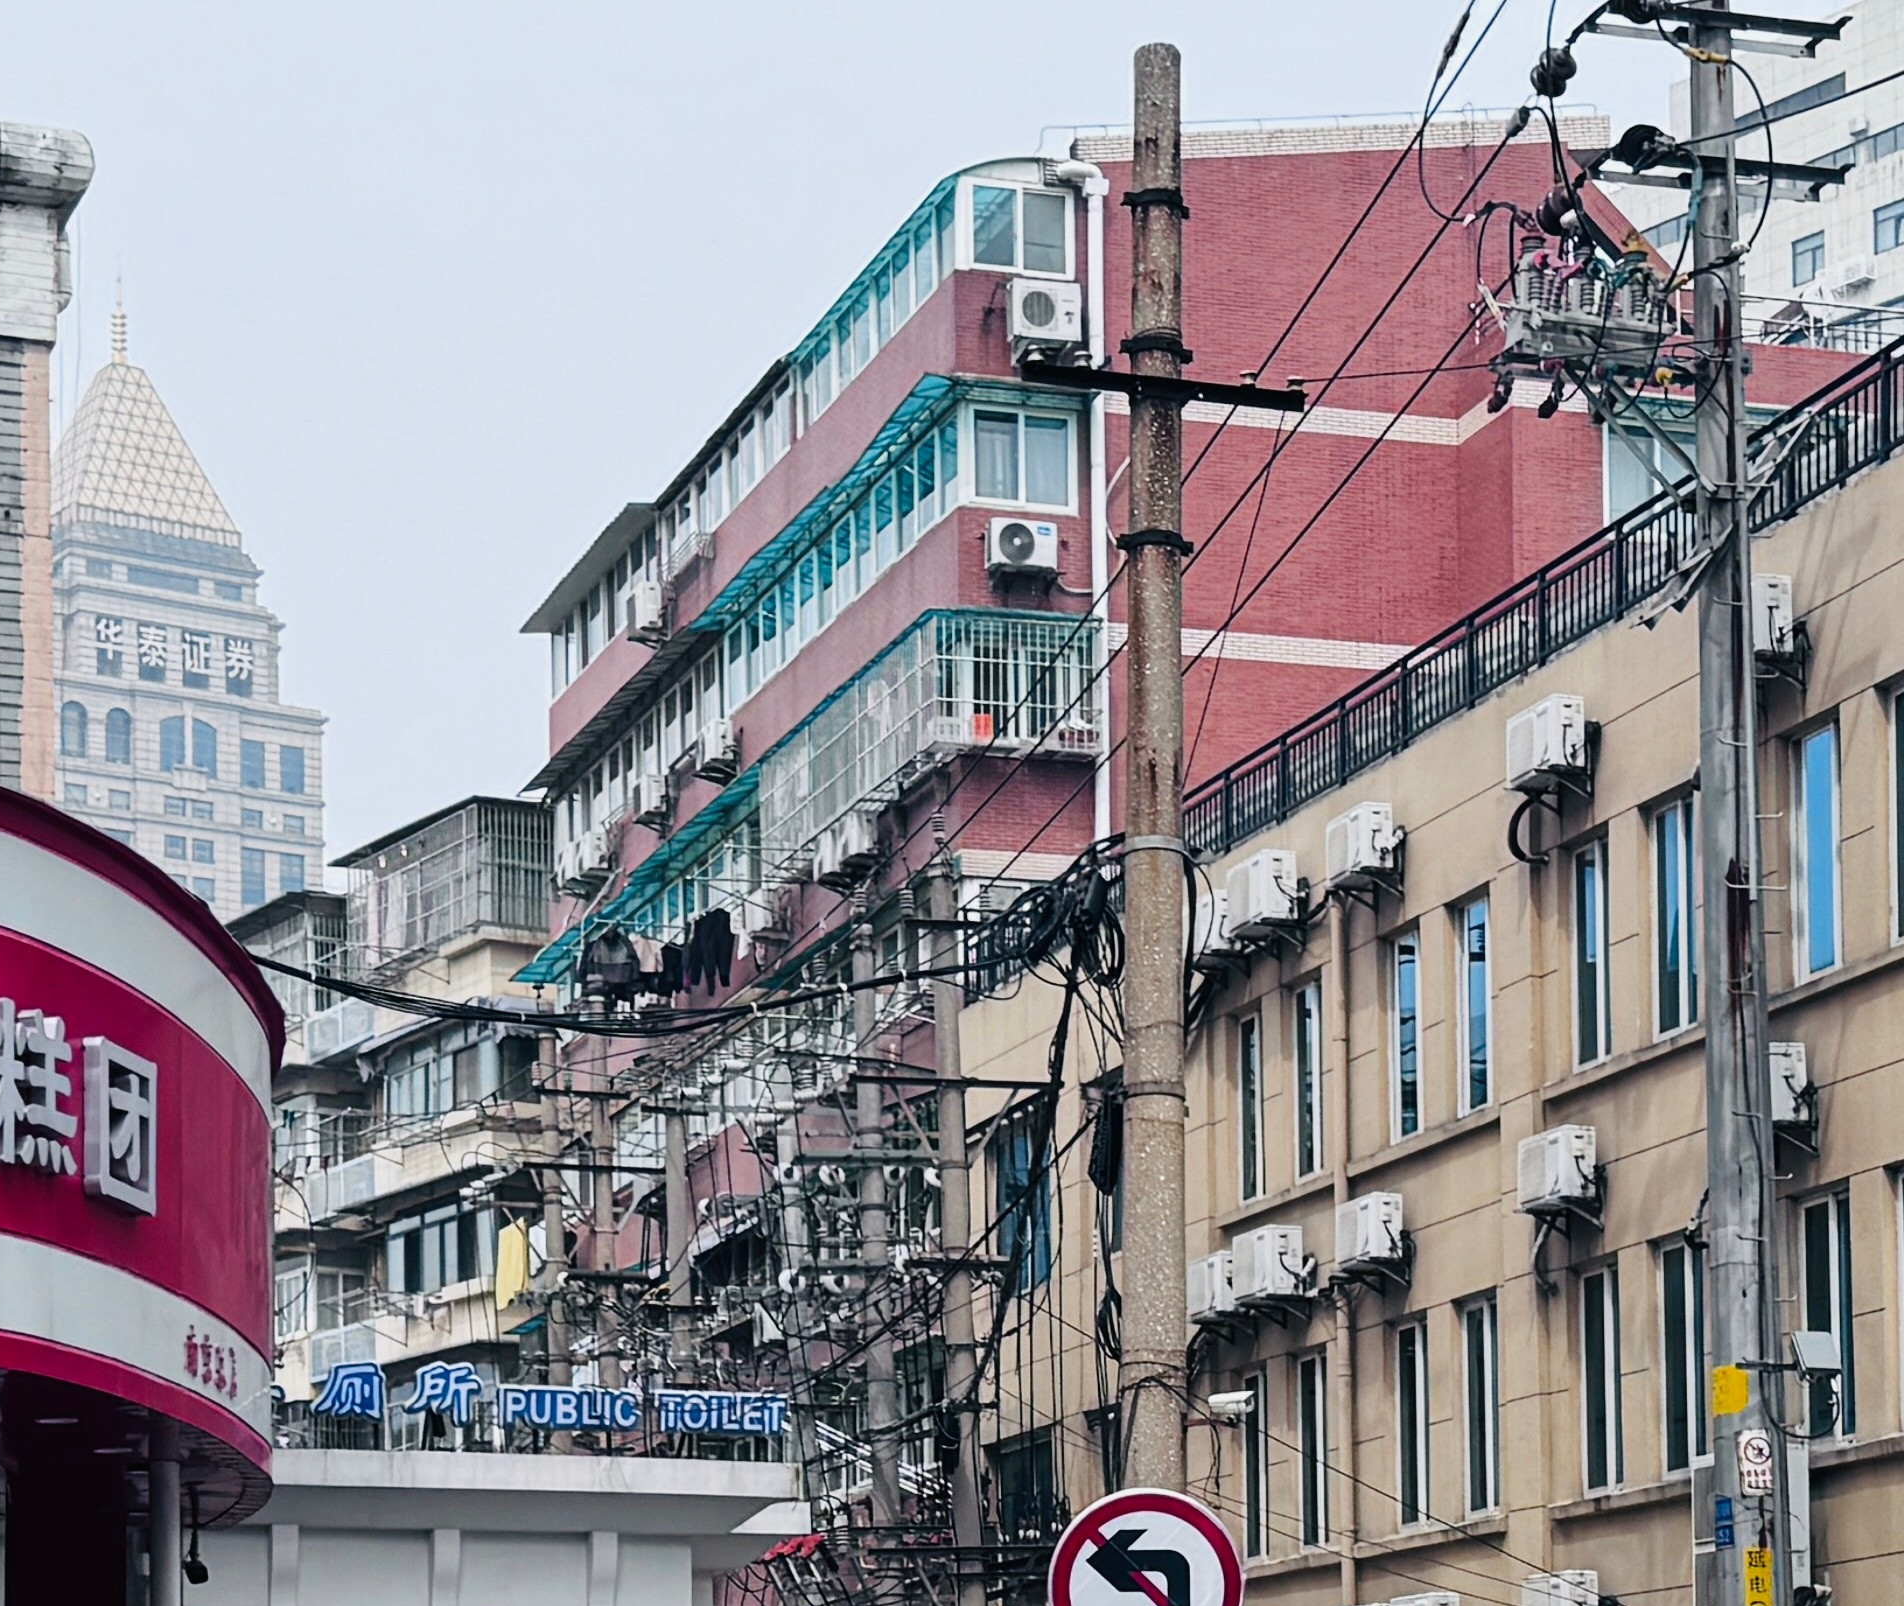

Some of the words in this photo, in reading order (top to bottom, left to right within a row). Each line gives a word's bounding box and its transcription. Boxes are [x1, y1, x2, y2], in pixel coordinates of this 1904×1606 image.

[96, 618, 254, 680] 华泰证券
[501, 1386, 639, 1427] PUBLIC
[657, 1391, 787, 1434] TOILET
